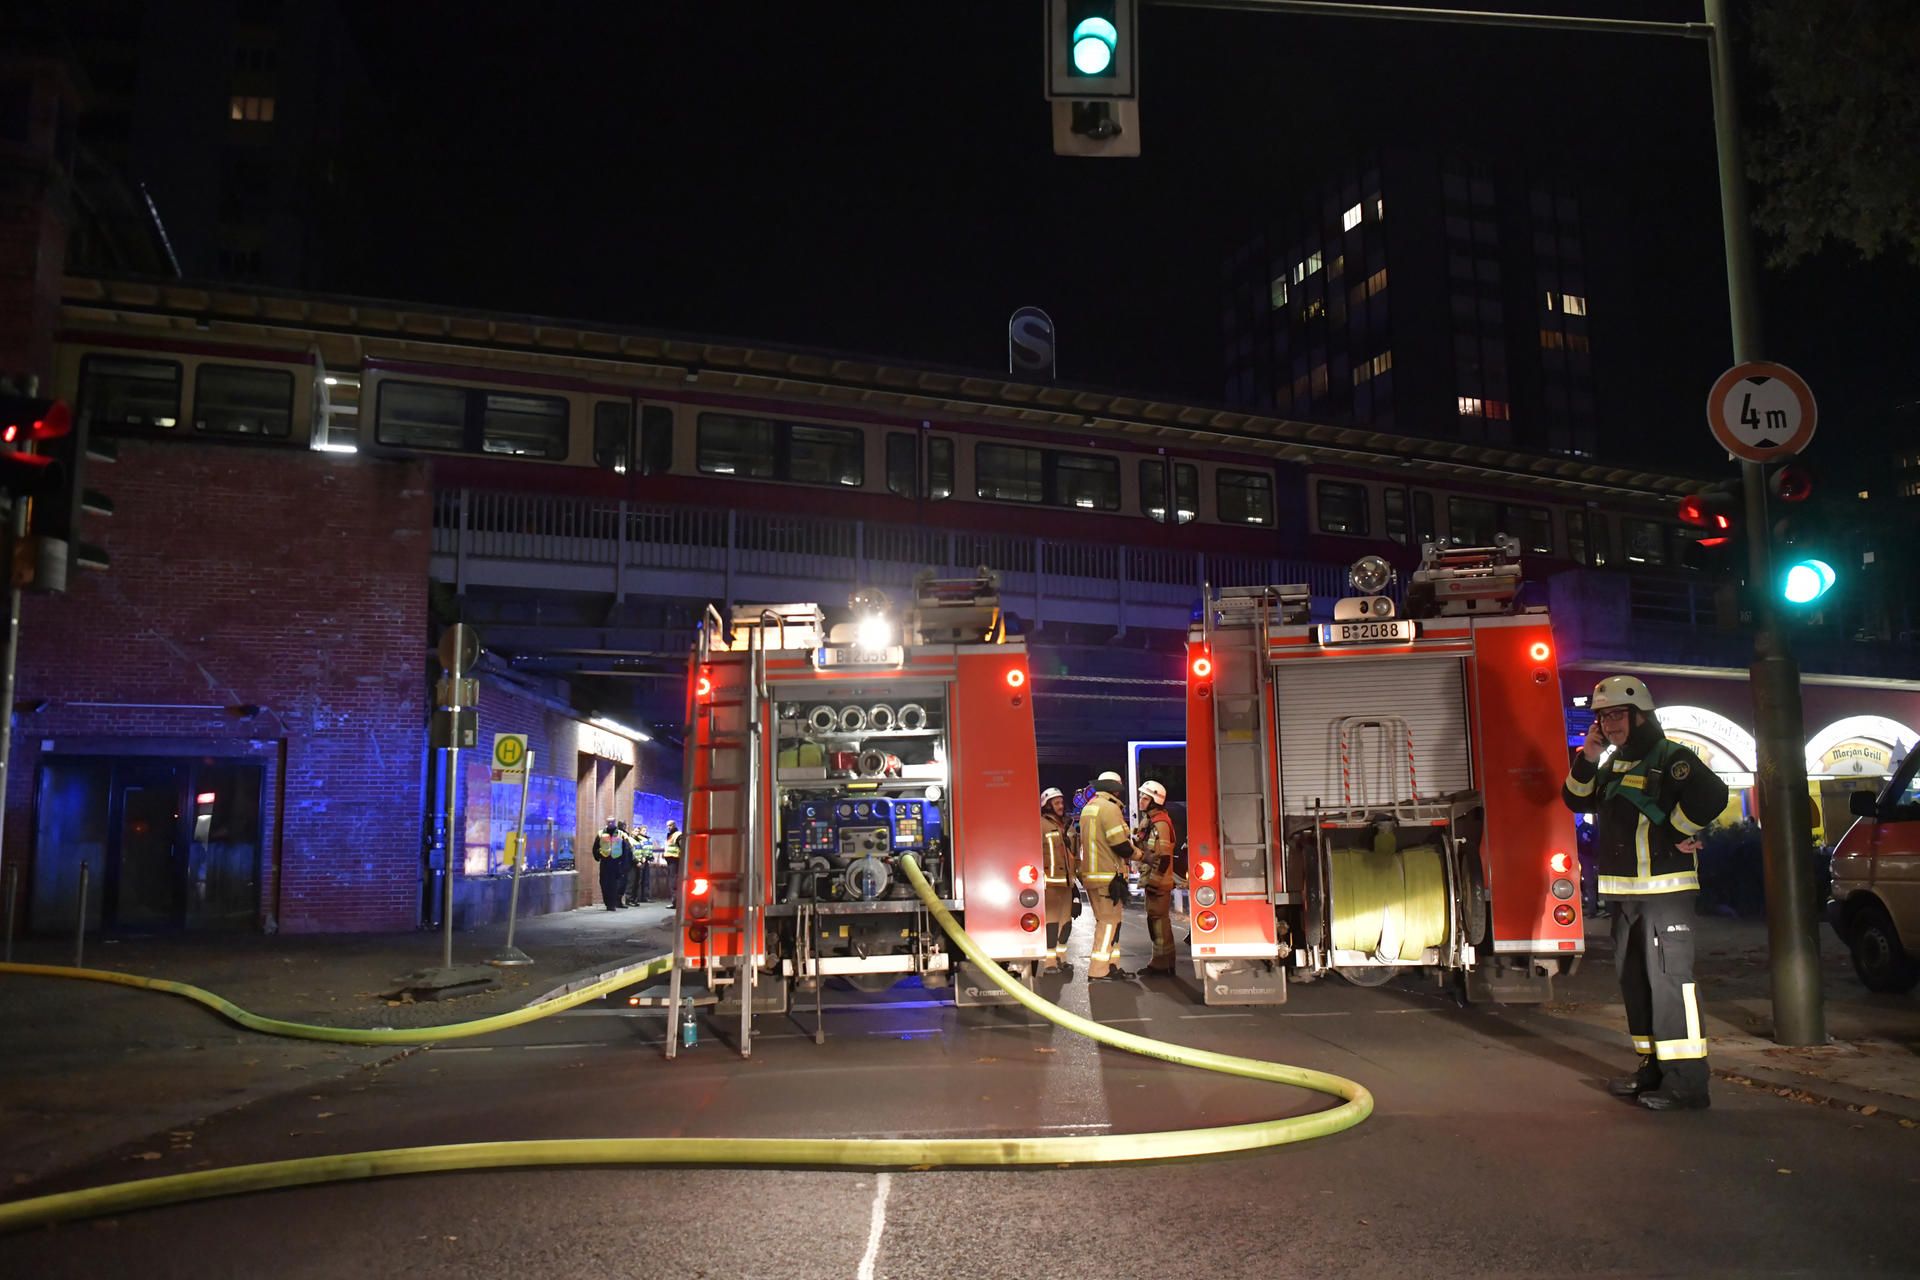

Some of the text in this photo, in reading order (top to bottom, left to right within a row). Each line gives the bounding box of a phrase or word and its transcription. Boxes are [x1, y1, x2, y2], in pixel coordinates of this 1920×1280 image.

[1012, 315, 1051, 370] S
[1740, 393, 1787, 430] 4 m
[1342, 623, 1399, 639] B 2088
[836, 649, 844, 663] B
[504, 742, 515, 760] H
[1832, 747, 1882, 761] Marjan Grill
